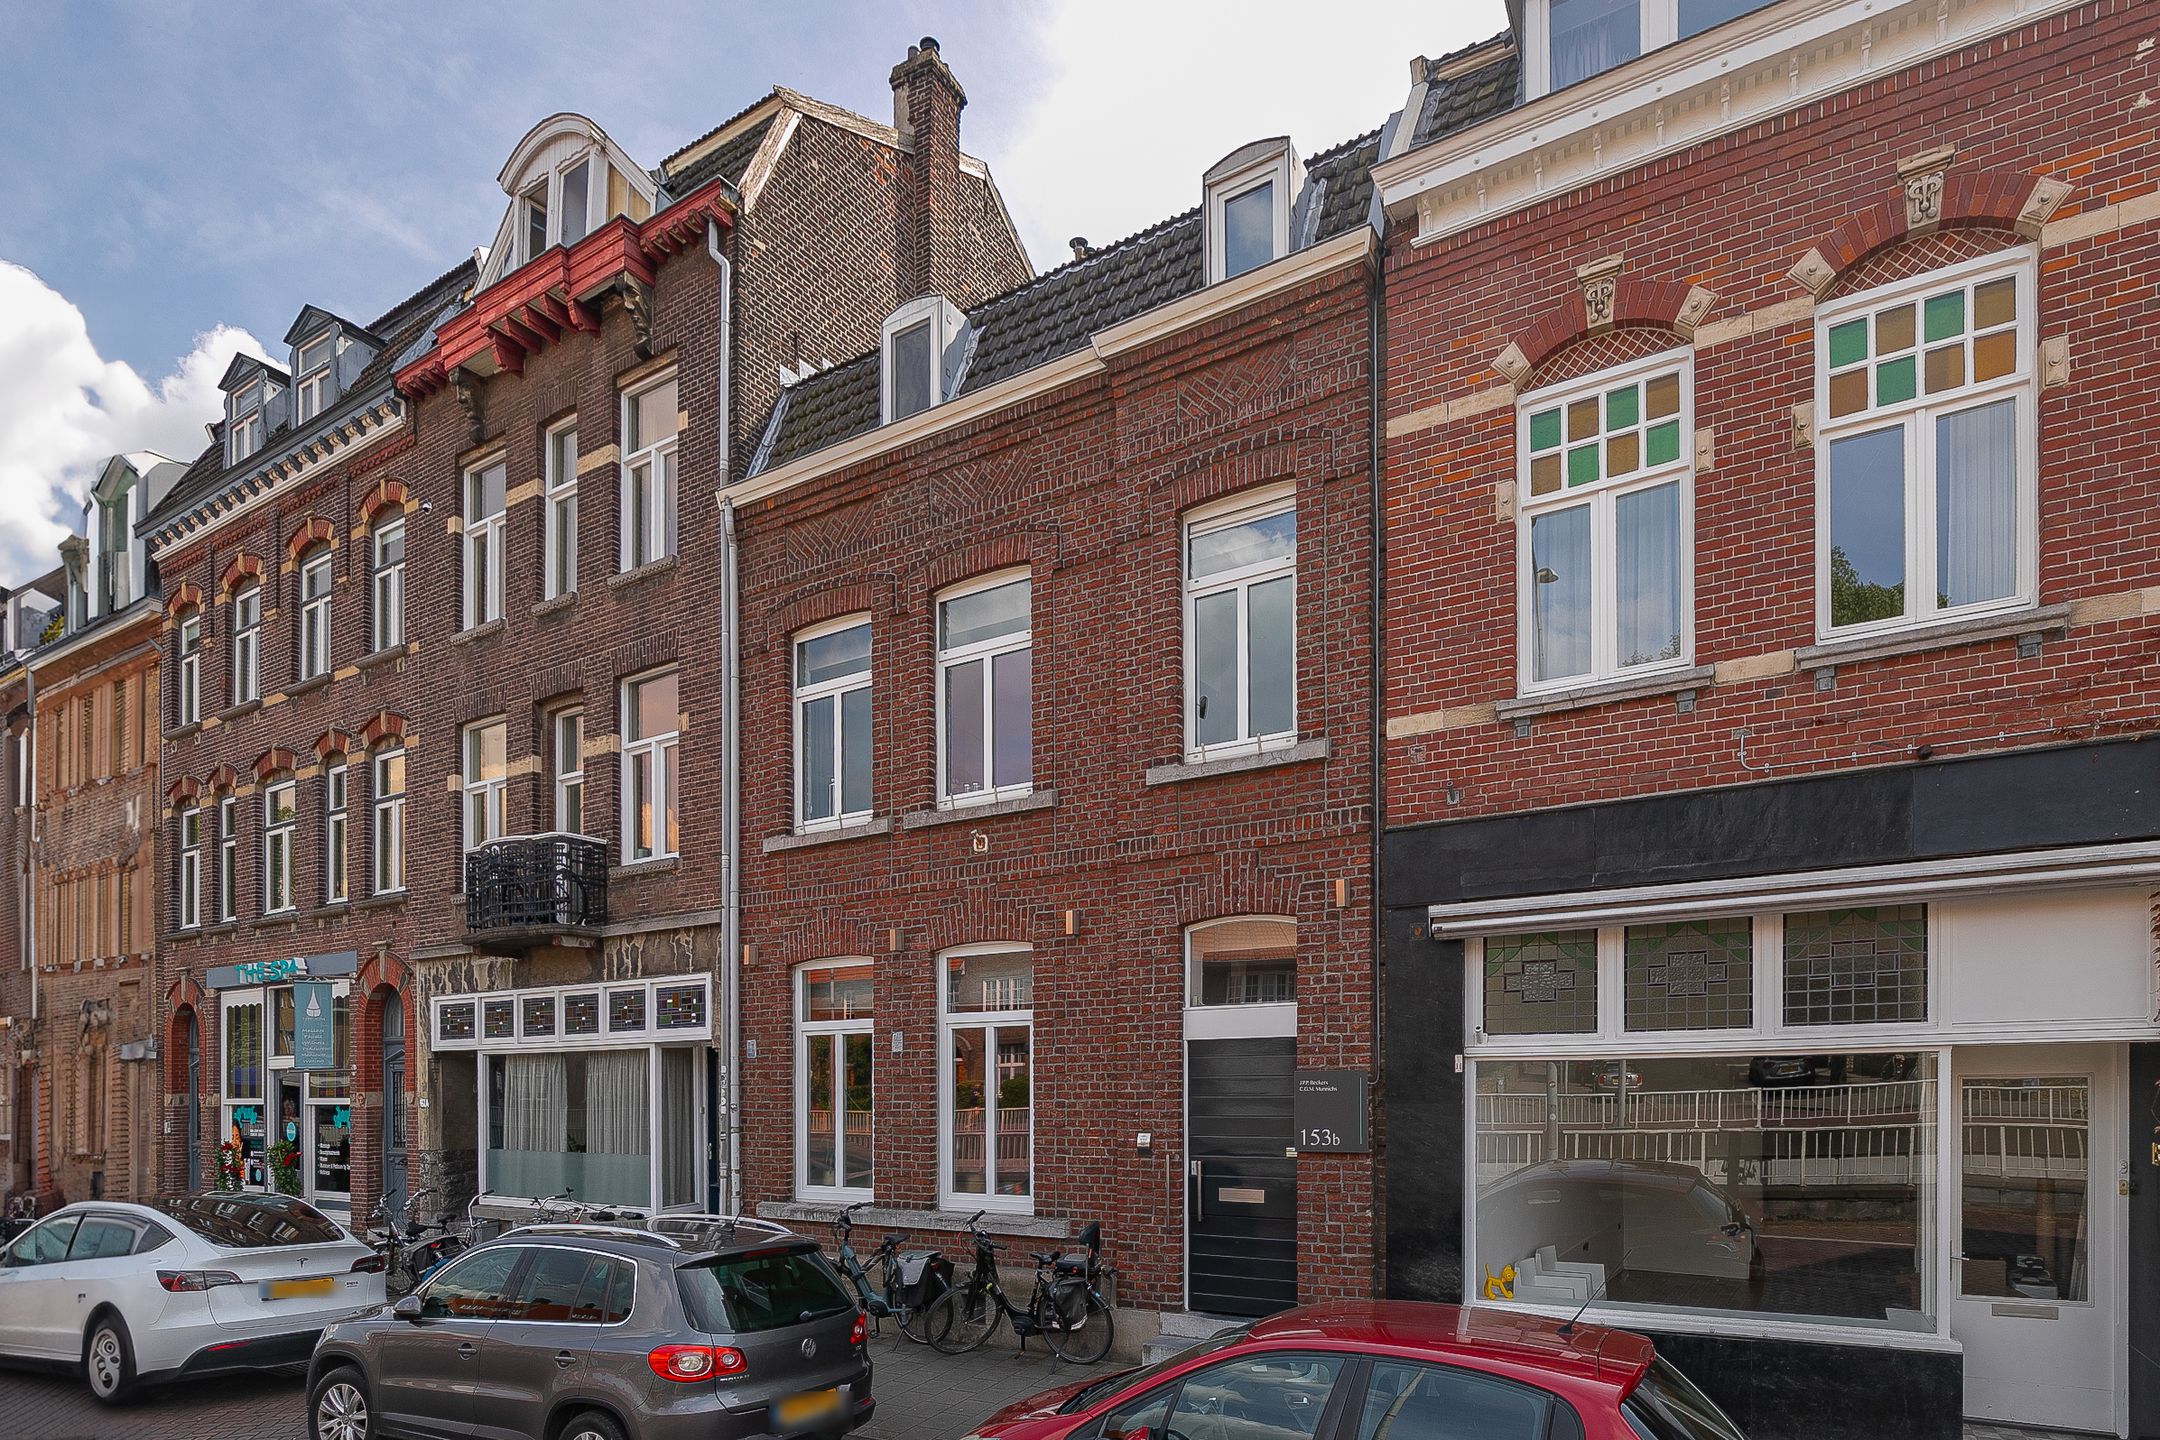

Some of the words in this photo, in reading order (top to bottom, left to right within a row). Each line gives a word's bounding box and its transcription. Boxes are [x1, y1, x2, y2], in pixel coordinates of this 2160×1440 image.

[234, 961, 264, 983] THE
[269, 958, 297, 981] SPA
[1300, 1128, 1341, 1146] 153b
